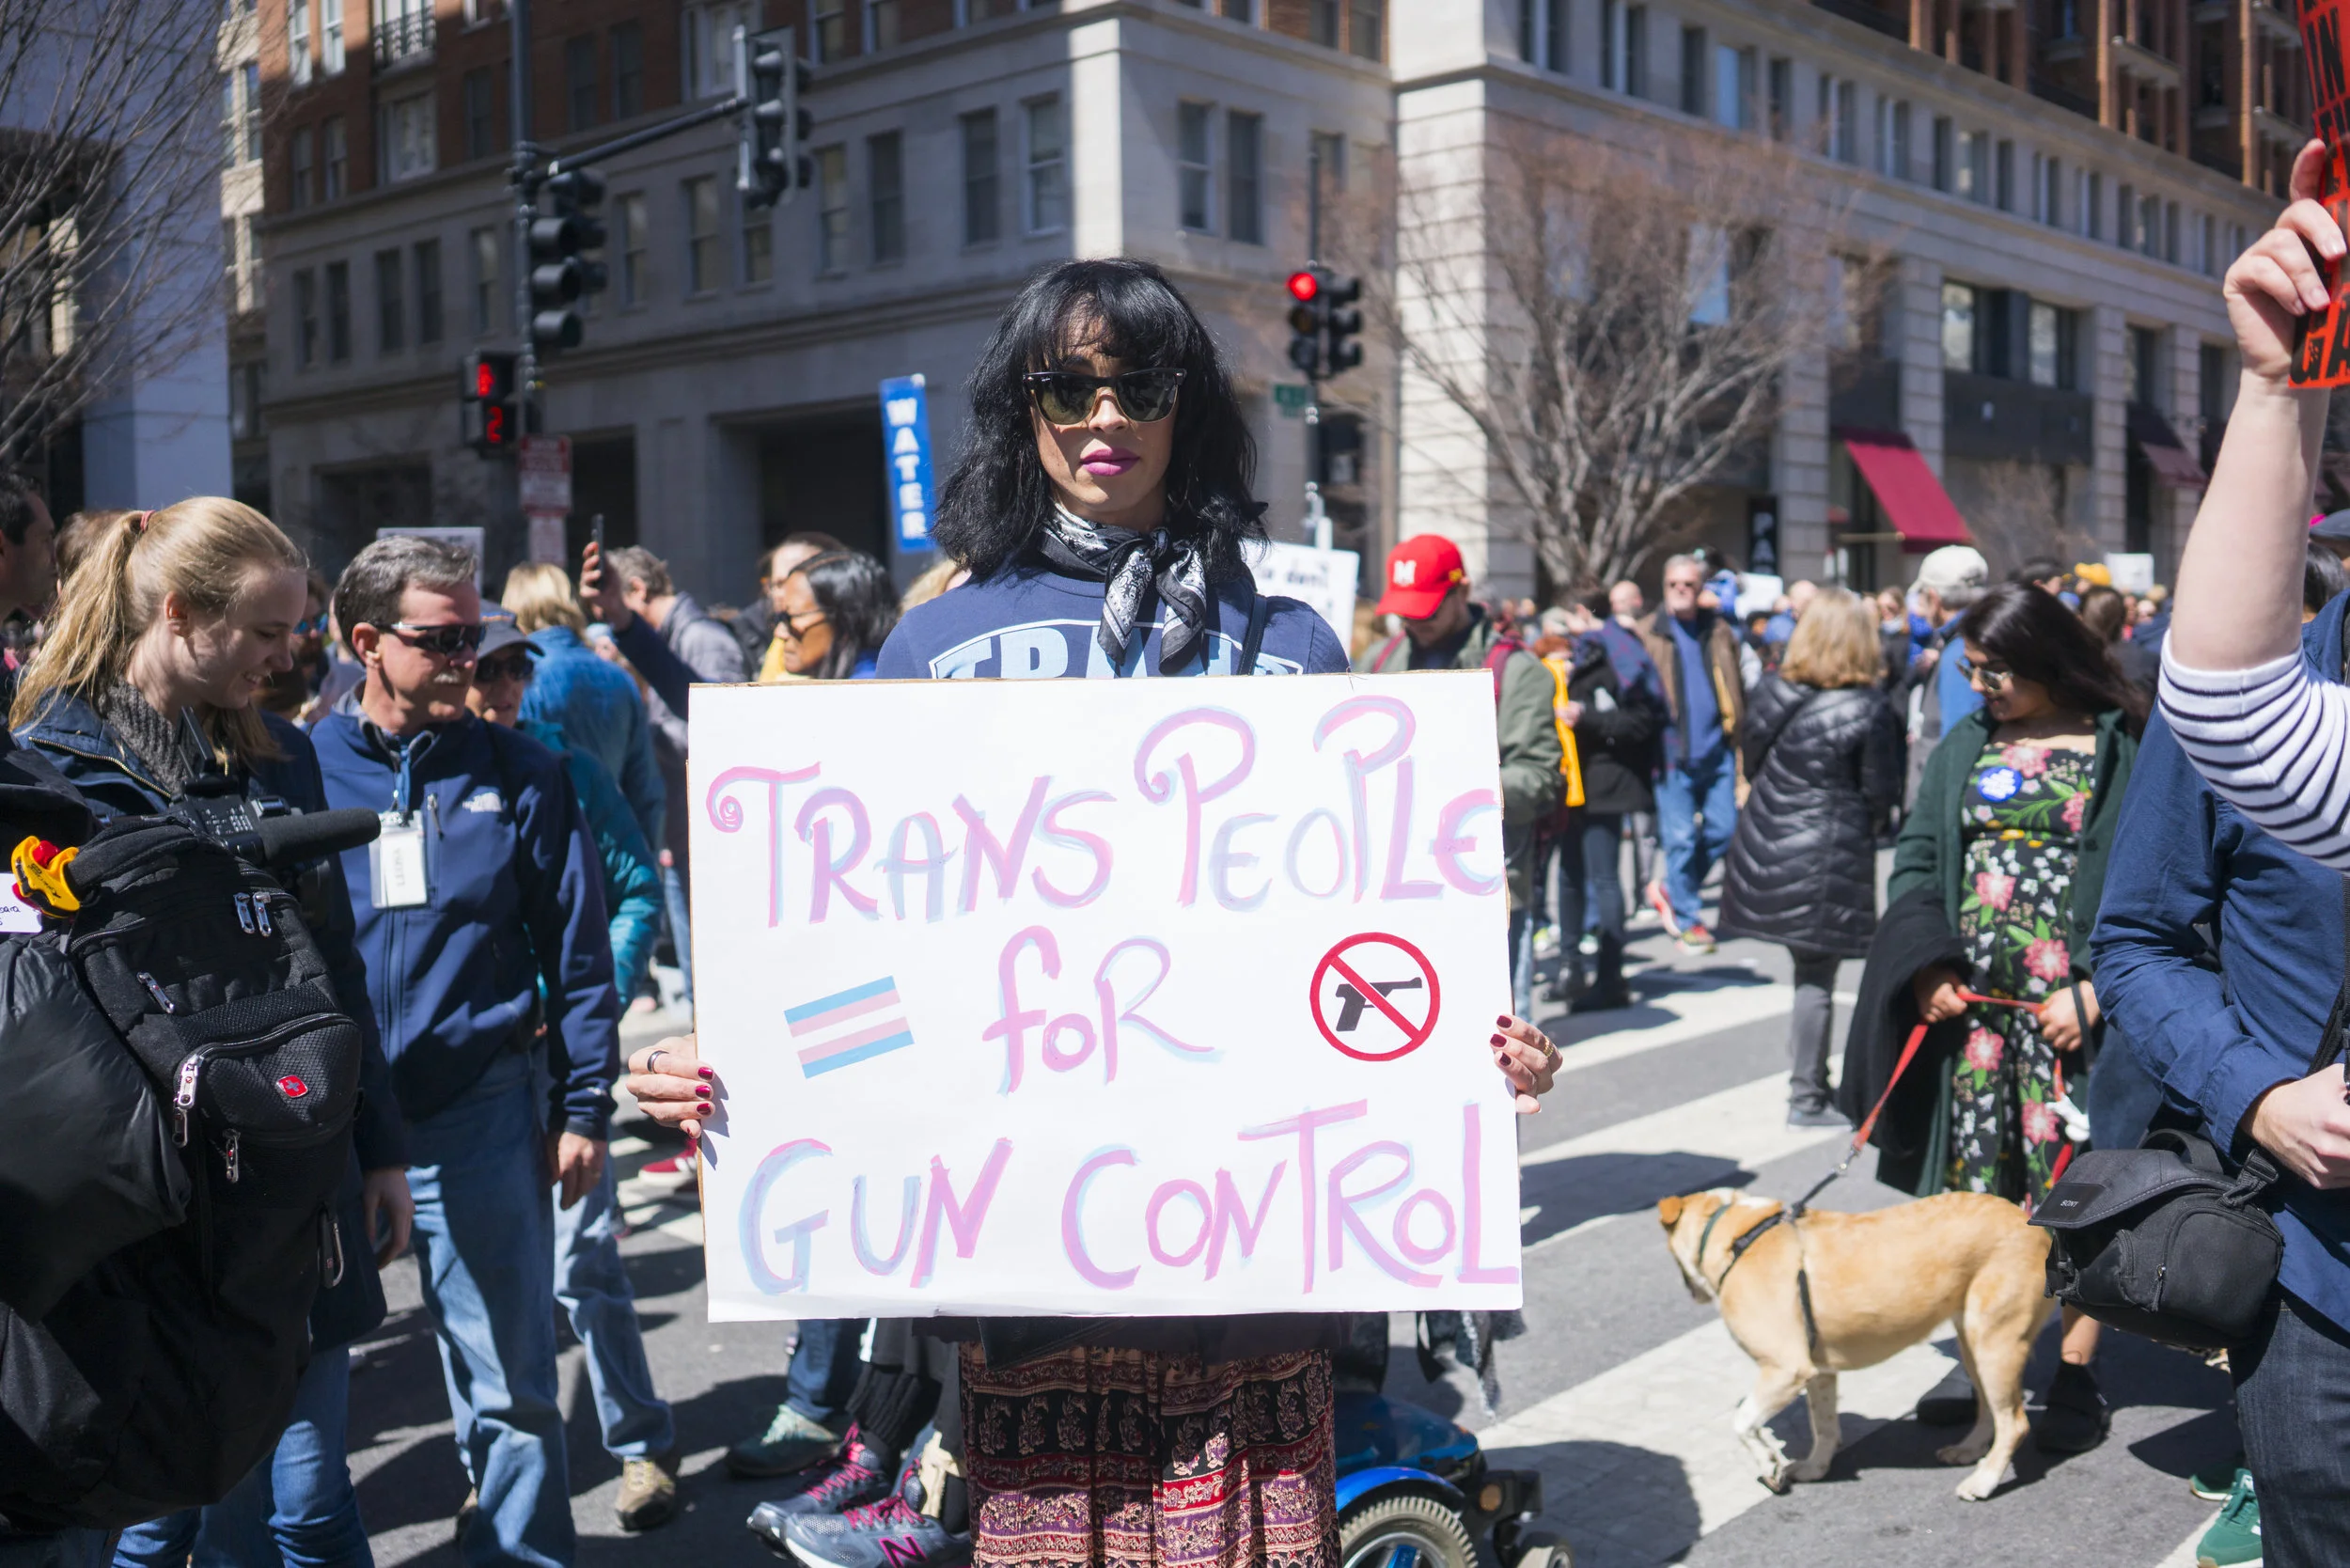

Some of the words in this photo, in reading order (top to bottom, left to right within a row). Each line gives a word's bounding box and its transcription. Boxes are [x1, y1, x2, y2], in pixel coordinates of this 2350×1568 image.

[885, 397, 927, 540] WATER
[707, 760, 1118, 929] TRANS
[1134, 694, 1506, 913] PEOPLE
[738, 1137, 1014, 1295] GUN
